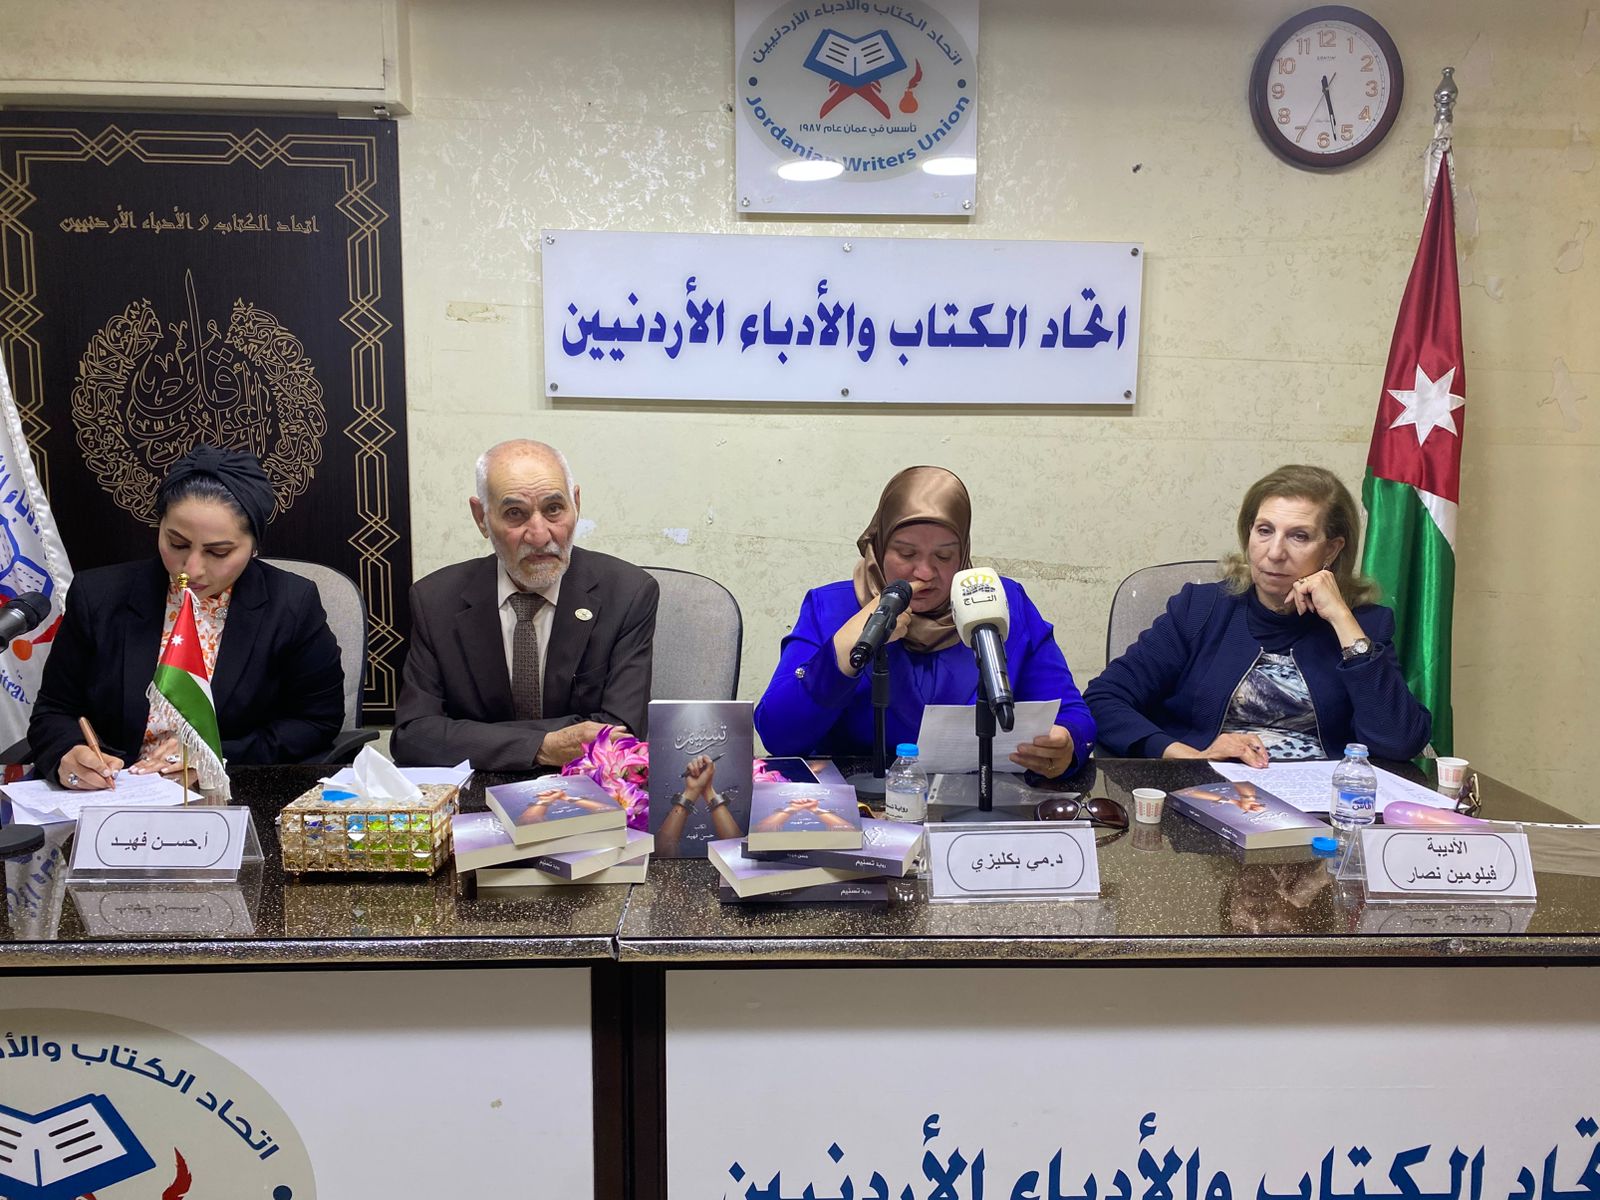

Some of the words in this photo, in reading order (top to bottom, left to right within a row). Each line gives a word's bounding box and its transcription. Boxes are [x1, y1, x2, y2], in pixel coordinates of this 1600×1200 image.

[873, 3, 927, 31] الكتاب
[1296, 37, 1311, 55] 11
[1317, 29, 1336, 47] 12
[1346, 36, 1354, 54] 1
[927, 30, 963, 65] اتحاد
[1276, 57, 1296, 74] 10
[1360, 55, 1374, 72] 2
[1271, 82, 1285, 99] 9
[1365, 80, 1378, 97] 3
[1277, 107, 1291, 125] 8
[1358, 105, 1371, 122] 4
[746, 95, 839, 163] Jordania
[842, 148, 917, 172] Writers
[918, 95, 970, 151] Union
[823, 124, 842, 133] عام
[844, 123, 867, 134] عمان
[869, 124, 885, 136] في
[887, 122, 917, 134] تأسس
[1294, 125, 1307, 143] 7
[1341, 124, 1354, 141] 5
[1317, 131, 1330, 148] 6
[213, 212, 271, 235] الكتاب
[276, 214, 321, 234] اتحاد
[562, 276, 725, 362] الأردنيين
[739, 279, 876, 365] والأدباء
[1040, 287, 1127, 350] اتحاد
[889, 303, 1028, 367] الكتاب
[111, 831, 147, 851] فهيد
[1427, 837, 1468, 857] الأديبة
[971, 852, 1021, 872] بكليزي
[1406, 866, 1441, 883] نصار
[1447, 865, 1497, 884] فيلومين
[0, 1032, 62, 1062] والأ
[71, 1043, 196, 1094] الكتاب
[196, 1091, 280, 1160] اتحاد
